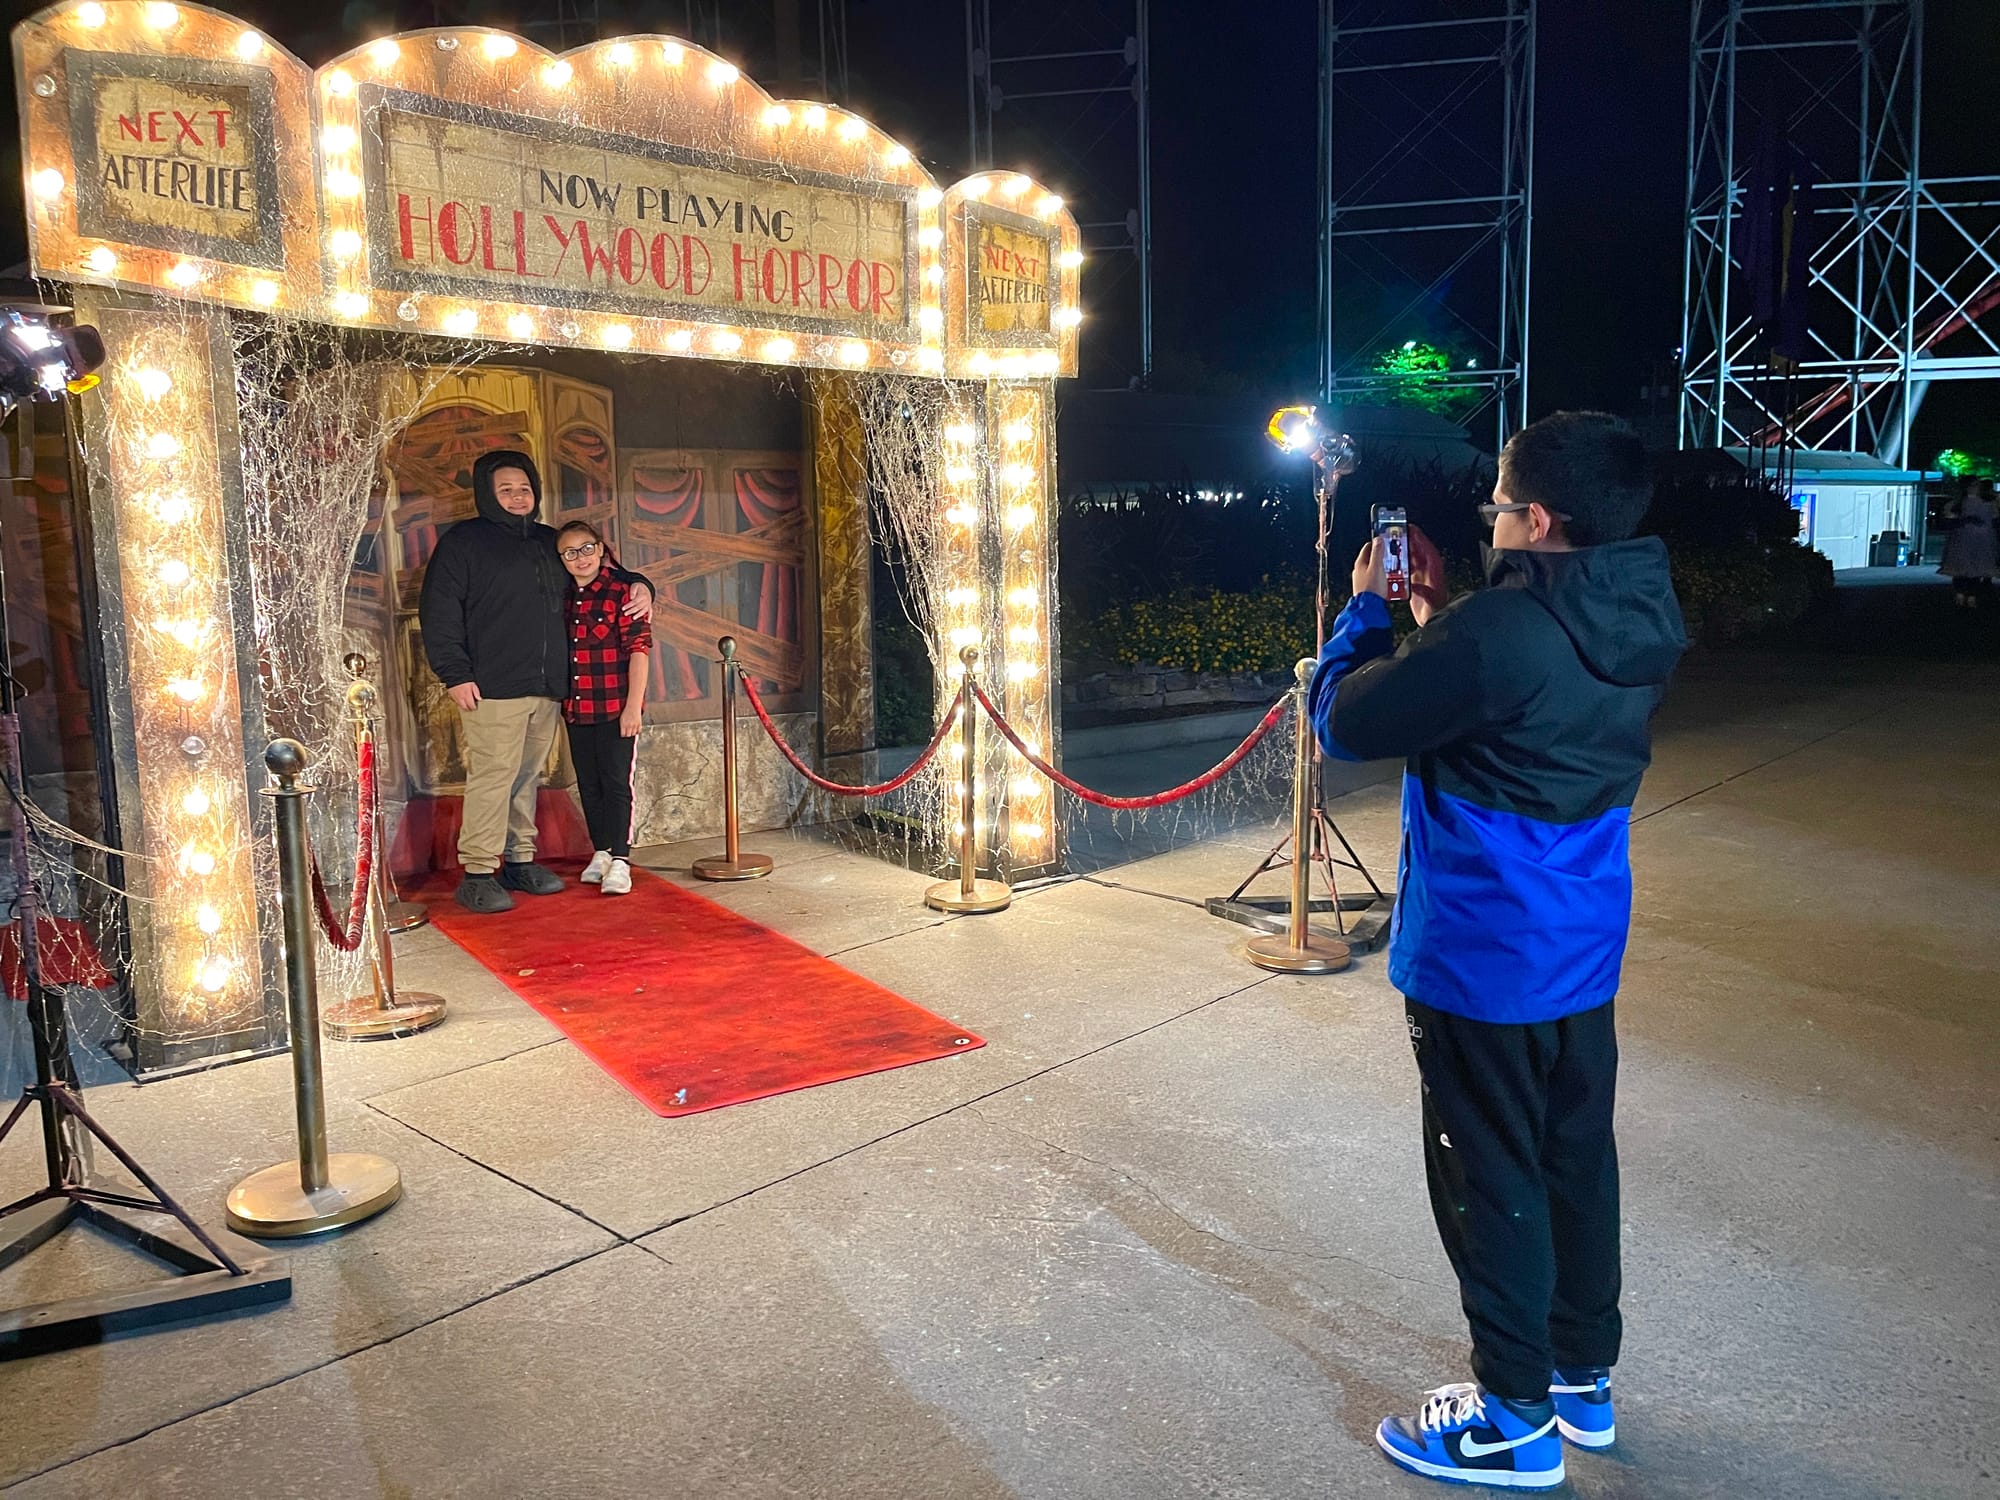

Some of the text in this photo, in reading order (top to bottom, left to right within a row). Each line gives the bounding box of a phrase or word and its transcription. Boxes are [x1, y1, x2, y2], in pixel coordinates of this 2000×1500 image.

[119, 110, 232, 149] NEXT
[102, 154, 251, 213] AFTERLIFE
[540, 168, 794, 243] NOW PLAYING
[397, 192, 895, 315] HOLLYWOOD HORROR
[984, 243, 1040, 278] NEXT
[980, 275, 1047, 305] AFTERLIFE
